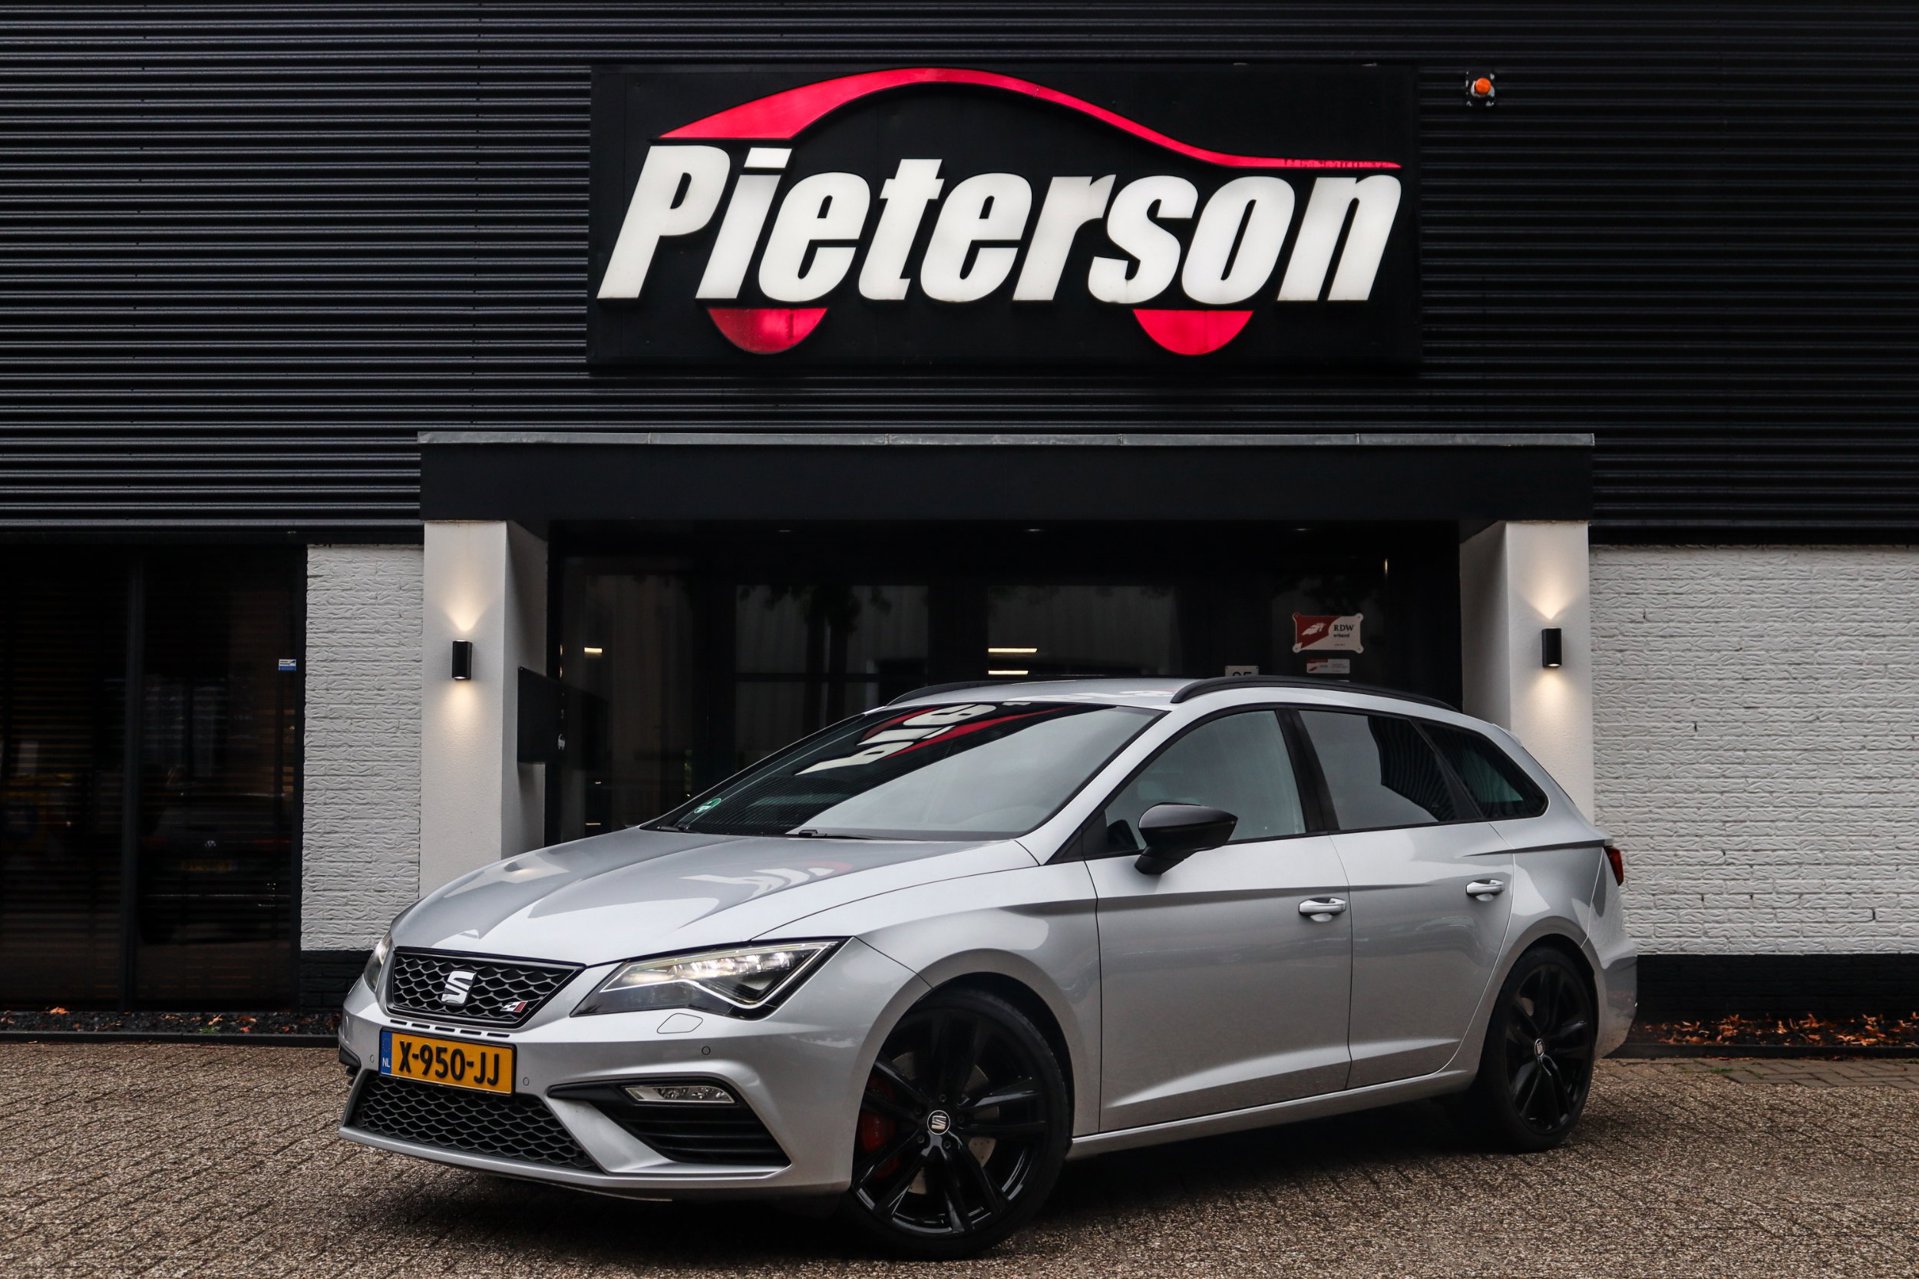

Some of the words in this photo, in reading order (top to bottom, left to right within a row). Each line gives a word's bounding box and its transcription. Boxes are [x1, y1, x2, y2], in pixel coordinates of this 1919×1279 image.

[597, 144, 1401, 305] Pieterson
[1333, 624, 1354, 632] RDW
[382, 1057, 391, 1068] NL
[398, 1041, 500, 1086] X-950-JJ
